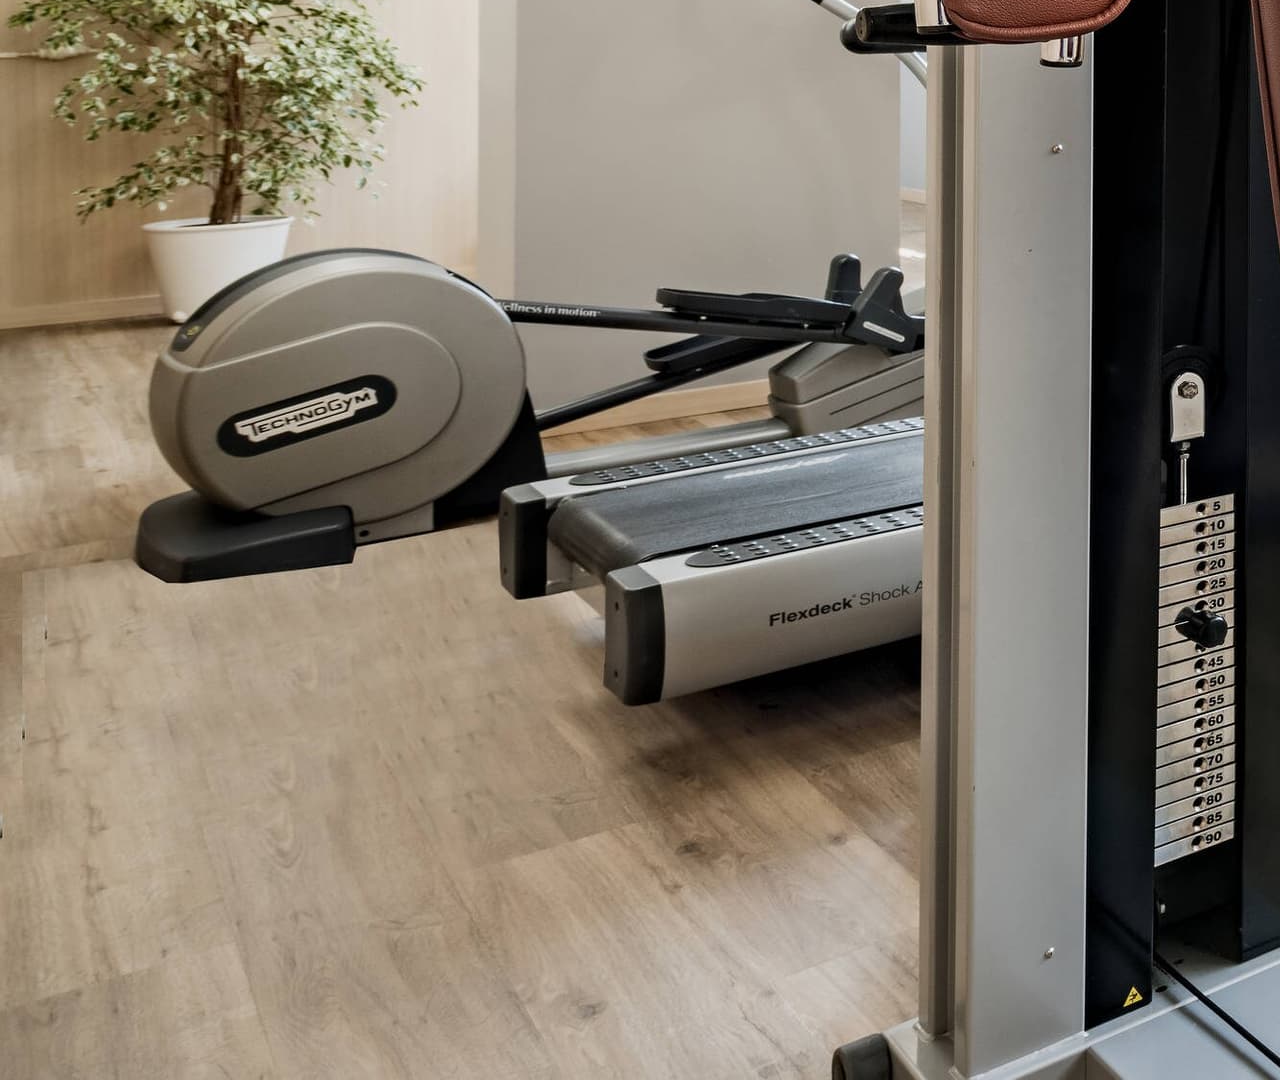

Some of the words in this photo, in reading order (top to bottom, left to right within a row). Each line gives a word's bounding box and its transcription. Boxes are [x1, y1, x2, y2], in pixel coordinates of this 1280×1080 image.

[544, 305, 556, 314] in
[558, 307, 598, 317] motion
[1212, 501, 1221, 511] 5
[1210, 520, 1225, 531] 10
[1210, 539, 1225, 550] 15
[1209, 558, 1226, 570] 20
[1210, 578, 1226, 590] 25
[769, 597, 852, 626] Flexdeck
[859, 584, 910, 606] Shock
[1209, 598, 1225, 609] 30
[1208, 656, 1224, 668] 45
[1209, 675, 1225, 686] 50
[1208, 694, 1225, 707] 55
[1207, 714, 1224, 727] 60
[1207, 733, 1223, 746] 65
[1207, 753, 1223, 765] 70
[1207, 773, 1223, 785] 75
[1206, 792, 1223, 805] 80
[1206, 812, 1223, 825] 85
[1205, 831, 1222, 843] 90
